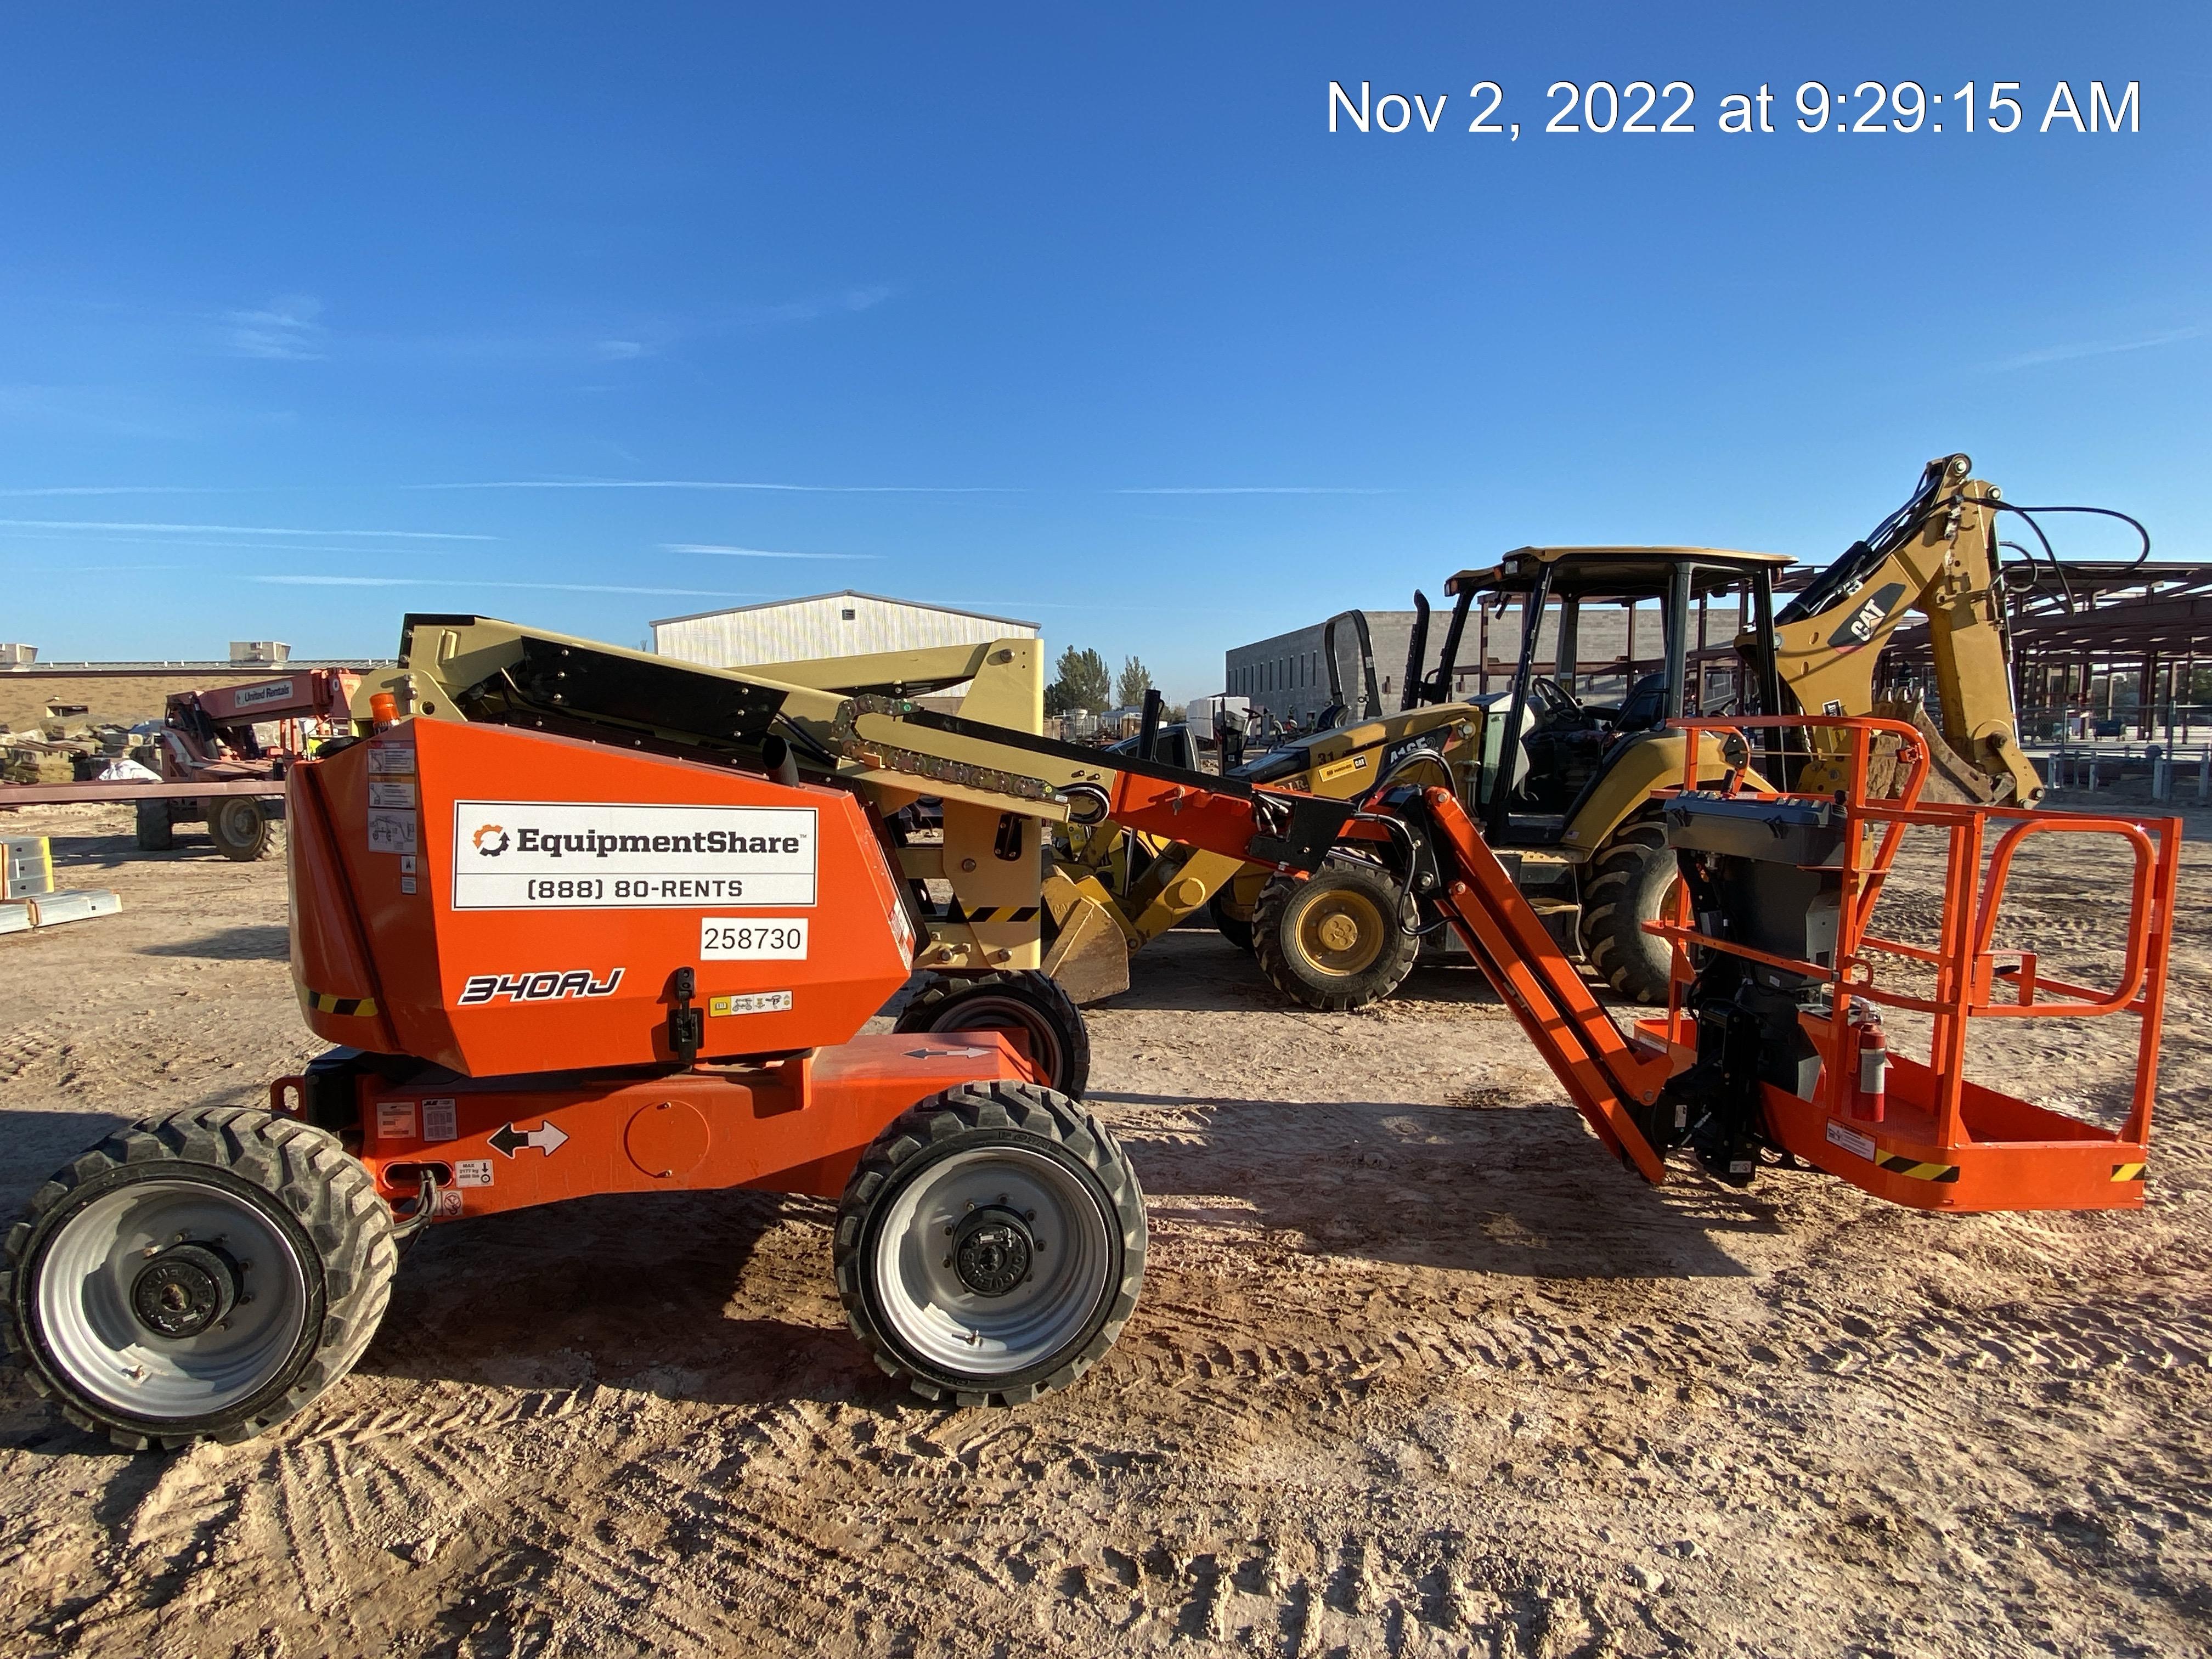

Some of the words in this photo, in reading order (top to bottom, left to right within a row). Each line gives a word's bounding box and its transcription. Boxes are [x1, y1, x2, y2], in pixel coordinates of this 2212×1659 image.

[1850, 599, 1886, 641] CAT
[244, 689, 264, 702] United
[266, 685, 290, 698] Rentals
[1355, 758, 1365, 767] CAT
[516, 828, 800, 858] EquipmentShare
[527, 879, 603, 900] (888)
[614, 880, 743, 898] 80-RENTS
[704, 928, 802, 950] 258730
[460, 969, 623, 1004] 340AJ
